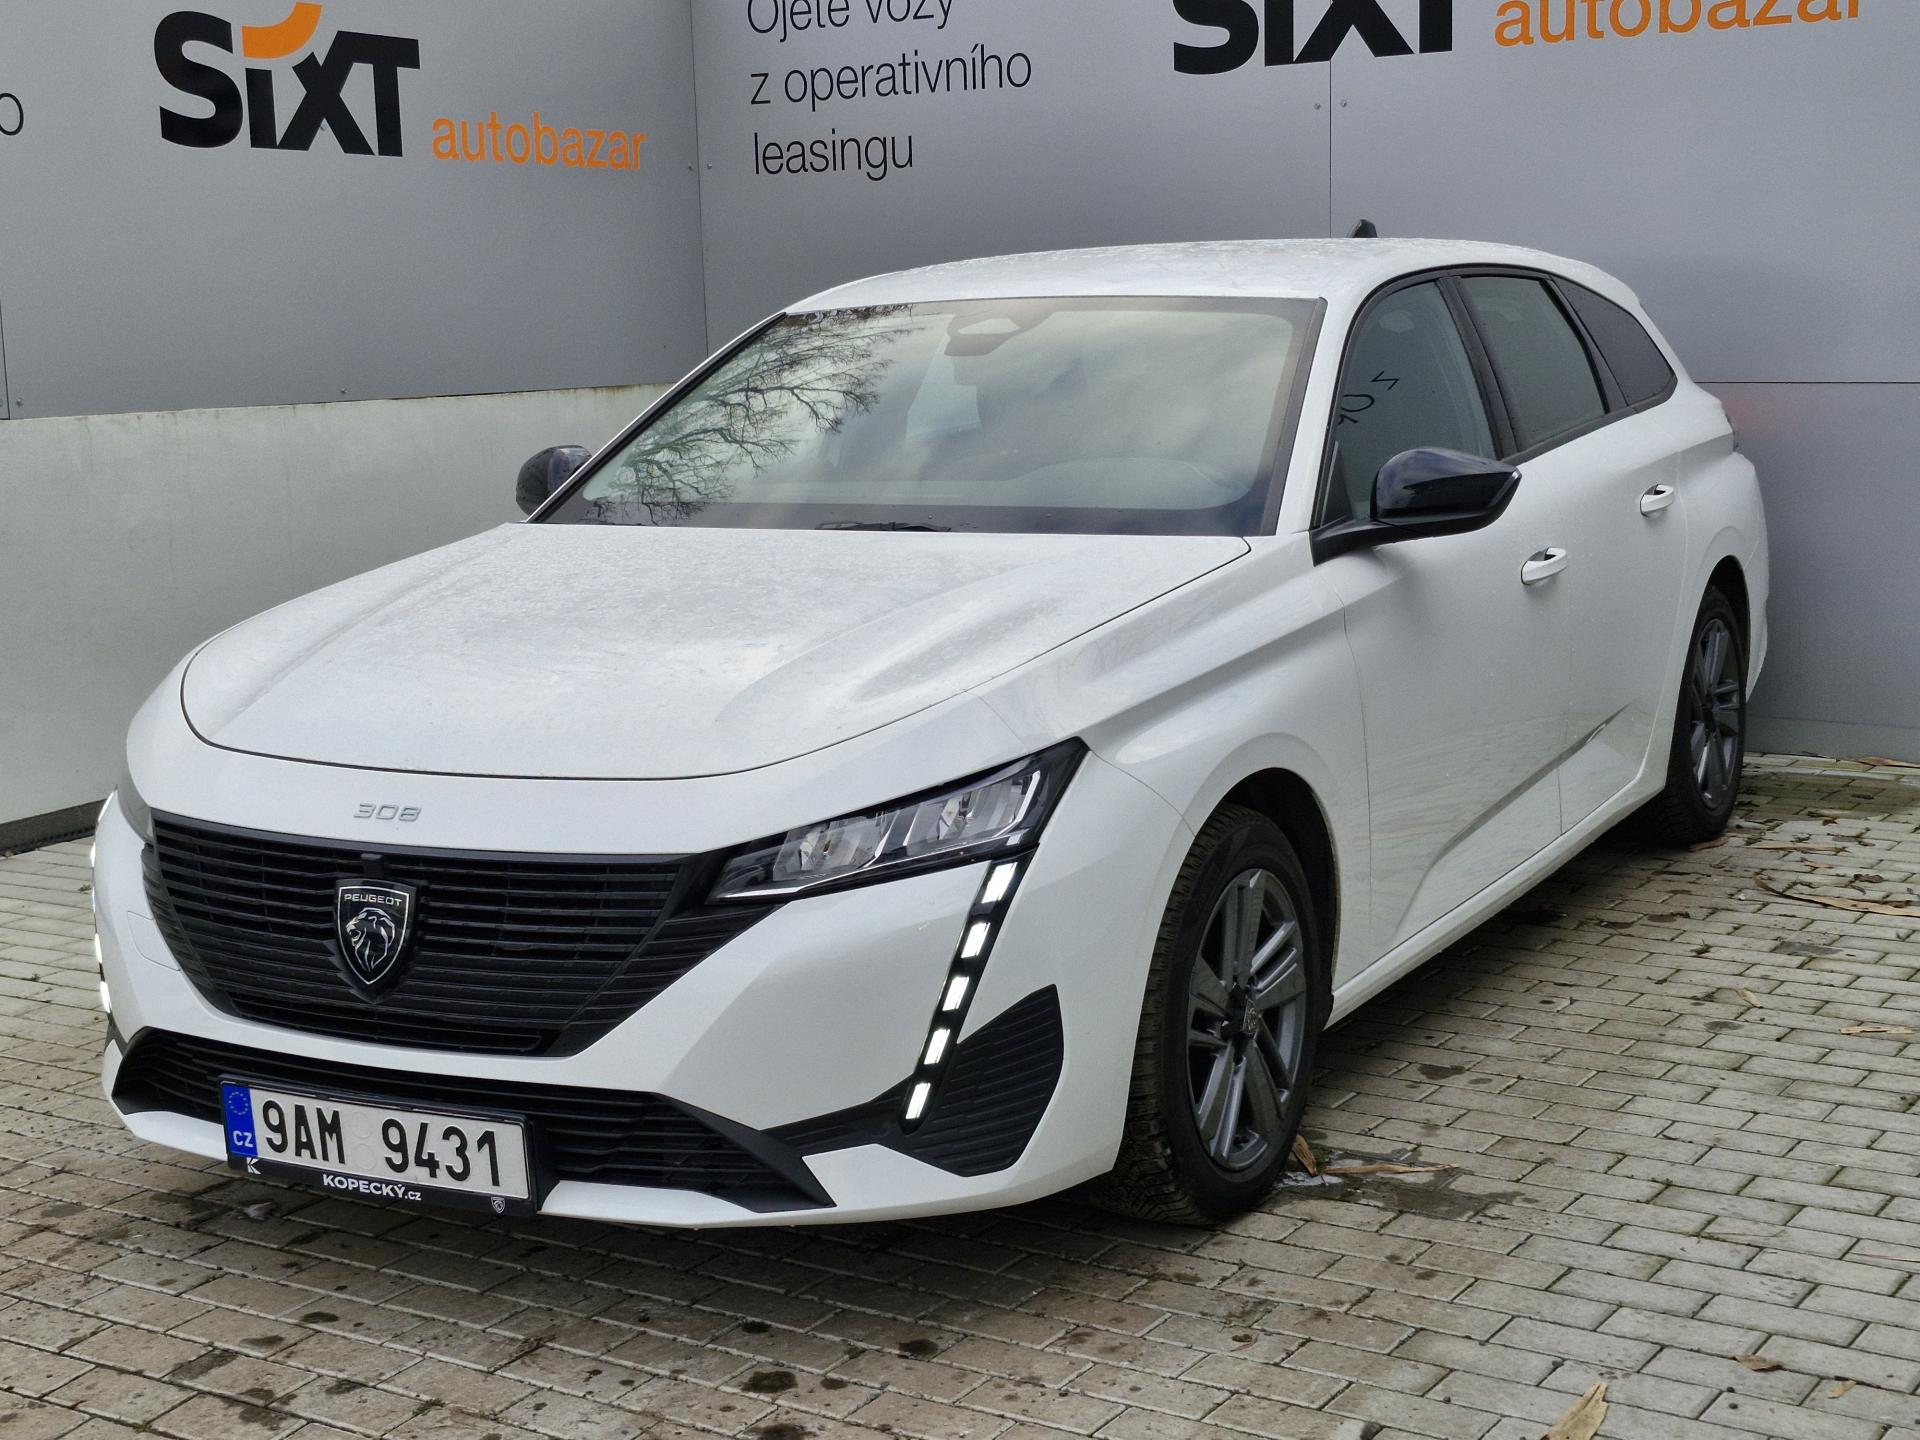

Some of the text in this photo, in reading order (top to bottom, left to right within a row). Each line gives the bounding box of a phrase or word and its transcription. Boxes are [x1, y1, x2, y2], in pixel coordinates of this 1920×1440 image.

[865, 0, 951, 30] vozy
[750, 44, 1032, 112] z operativního
[431, 111, 647, 170] autobazar
[754, 129, 914, 181] leasingu
[353, 803, 422, 822] 308
[344, 893, 403, 906] PEUGEOT
[232, 1130, 254, 1147] CZ
[262, 1099, 500, 1187] 9AM 9431
[322, 1173, 422, 1201] KOPECKÝ.cz
